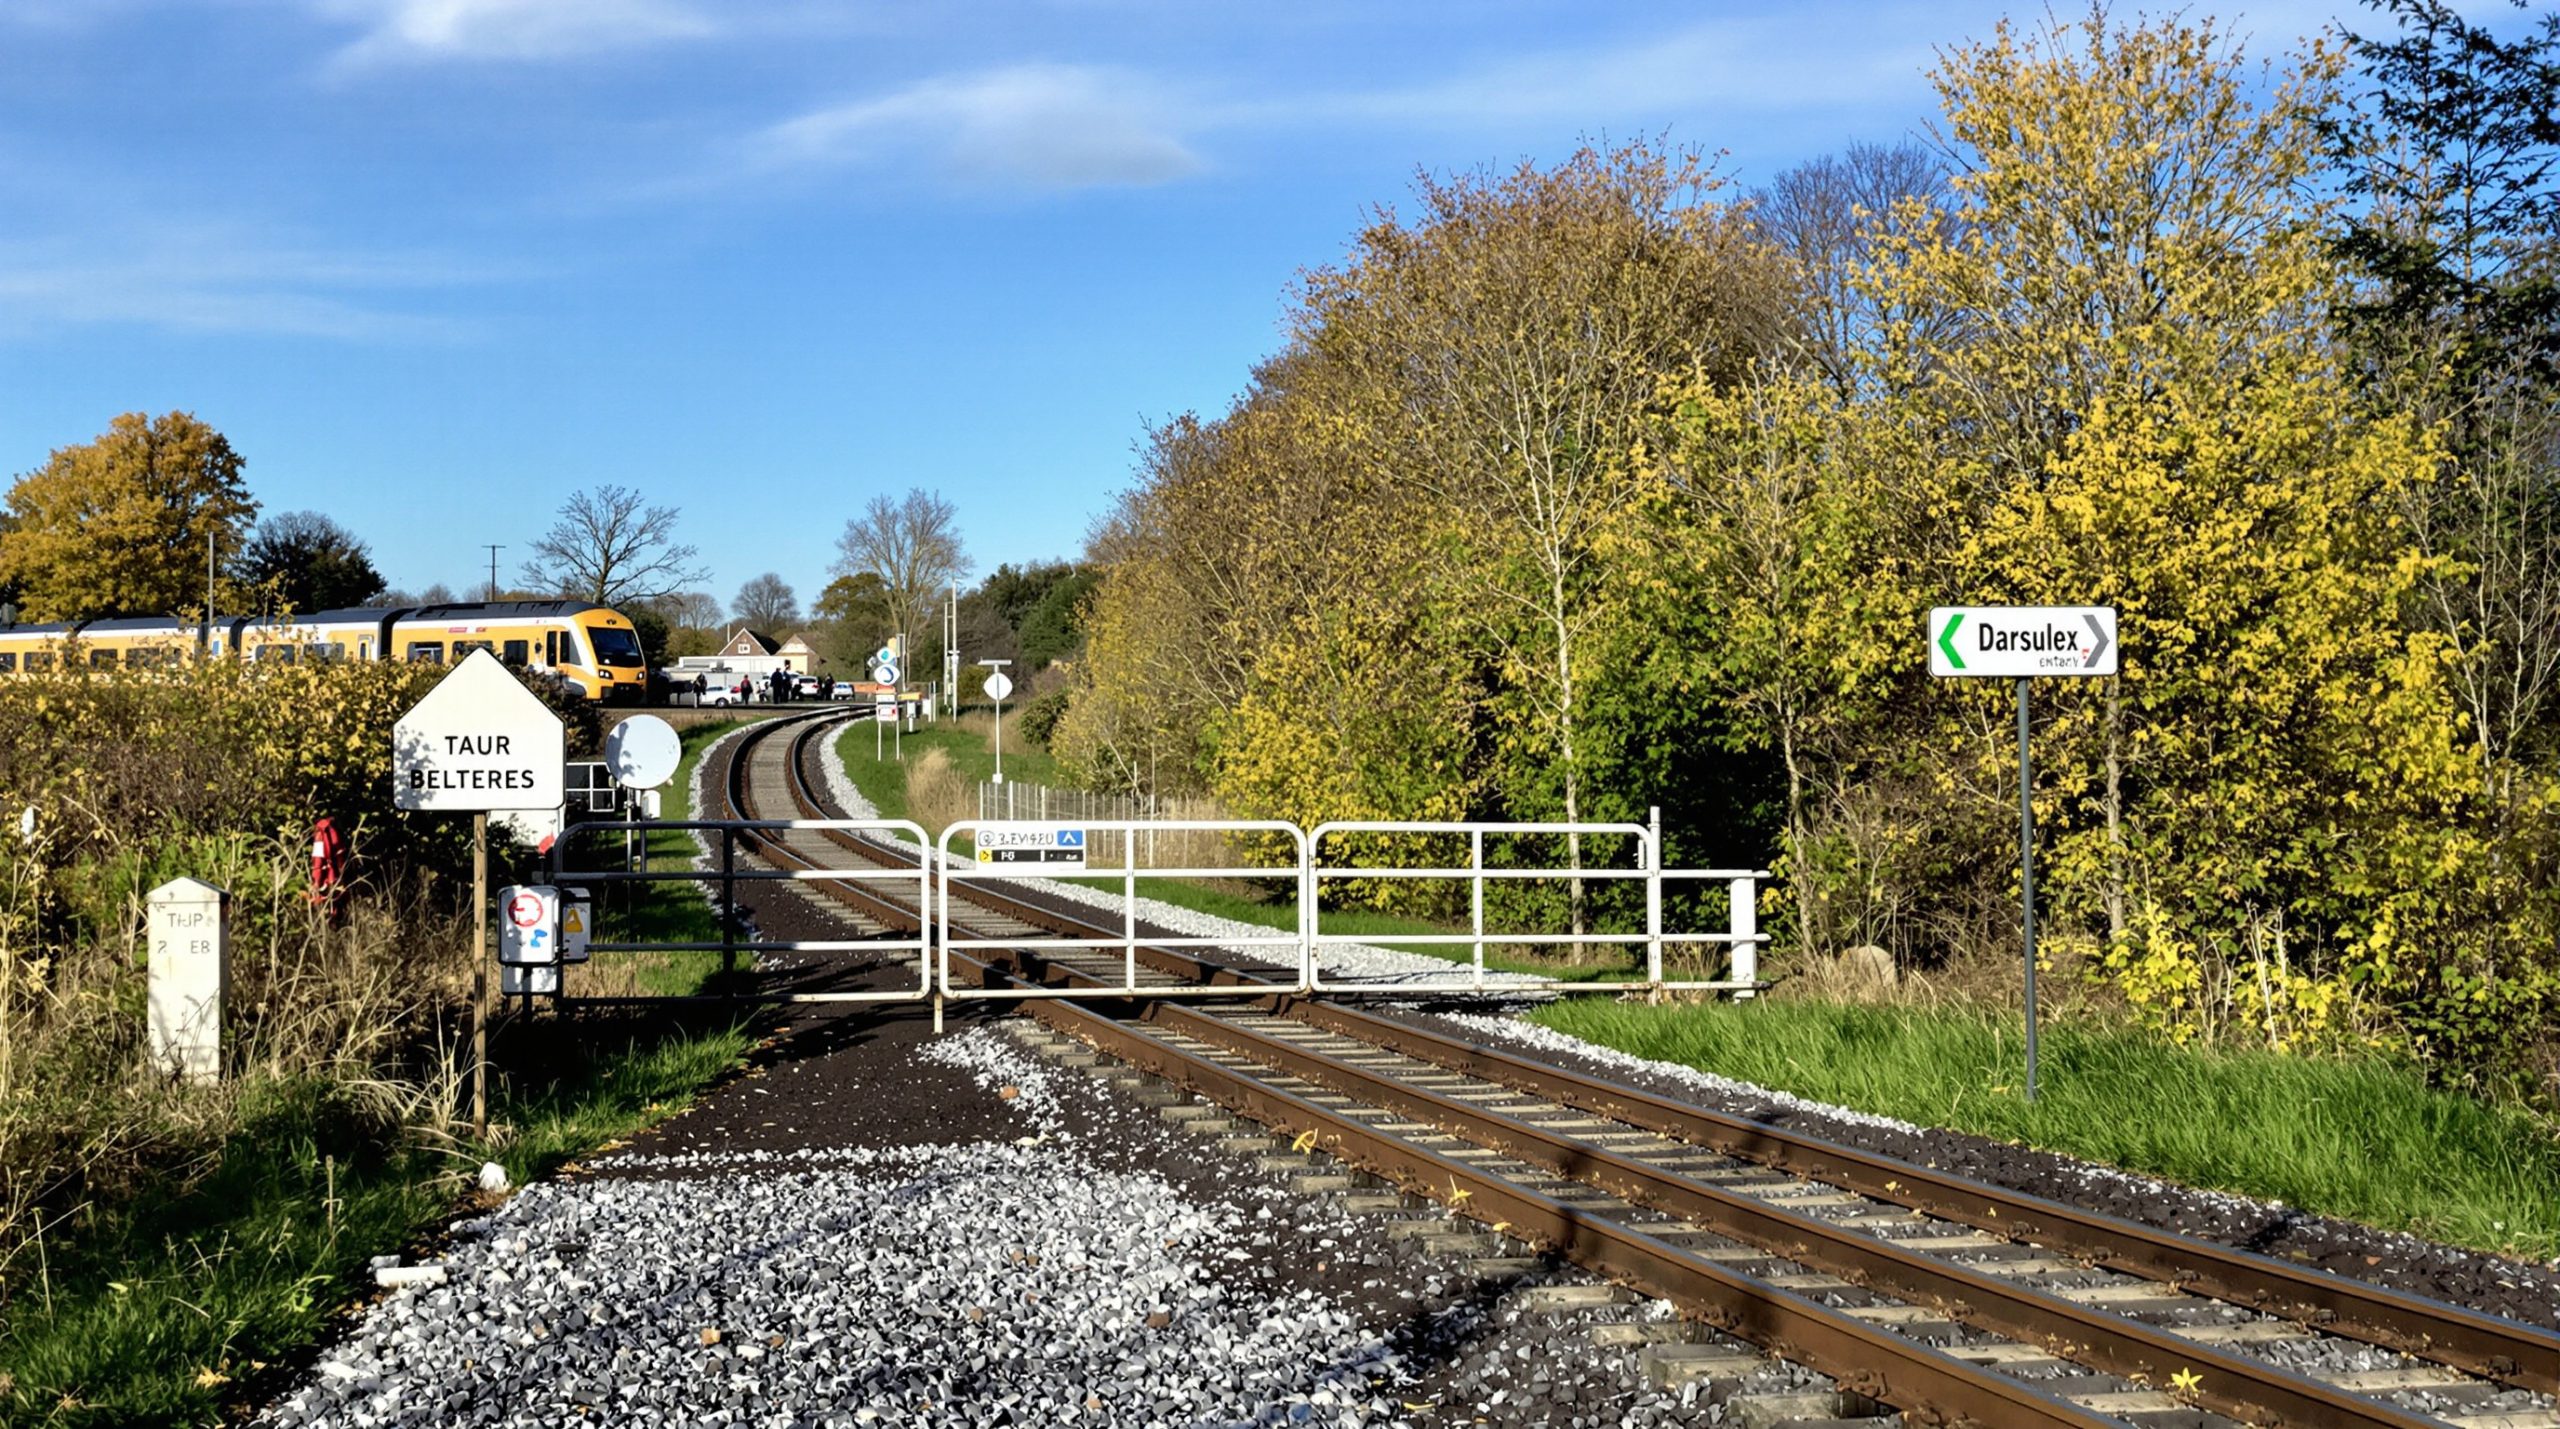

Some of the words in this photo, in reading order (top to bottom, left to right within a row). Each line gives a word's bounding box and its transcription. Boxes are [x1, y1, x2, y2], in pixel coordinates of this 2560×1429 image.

[1979, 623, 2078, 651] Darsulex
[445, 736, 510, 755] TAUR
[410, 770, 534, 789] BELTERES
